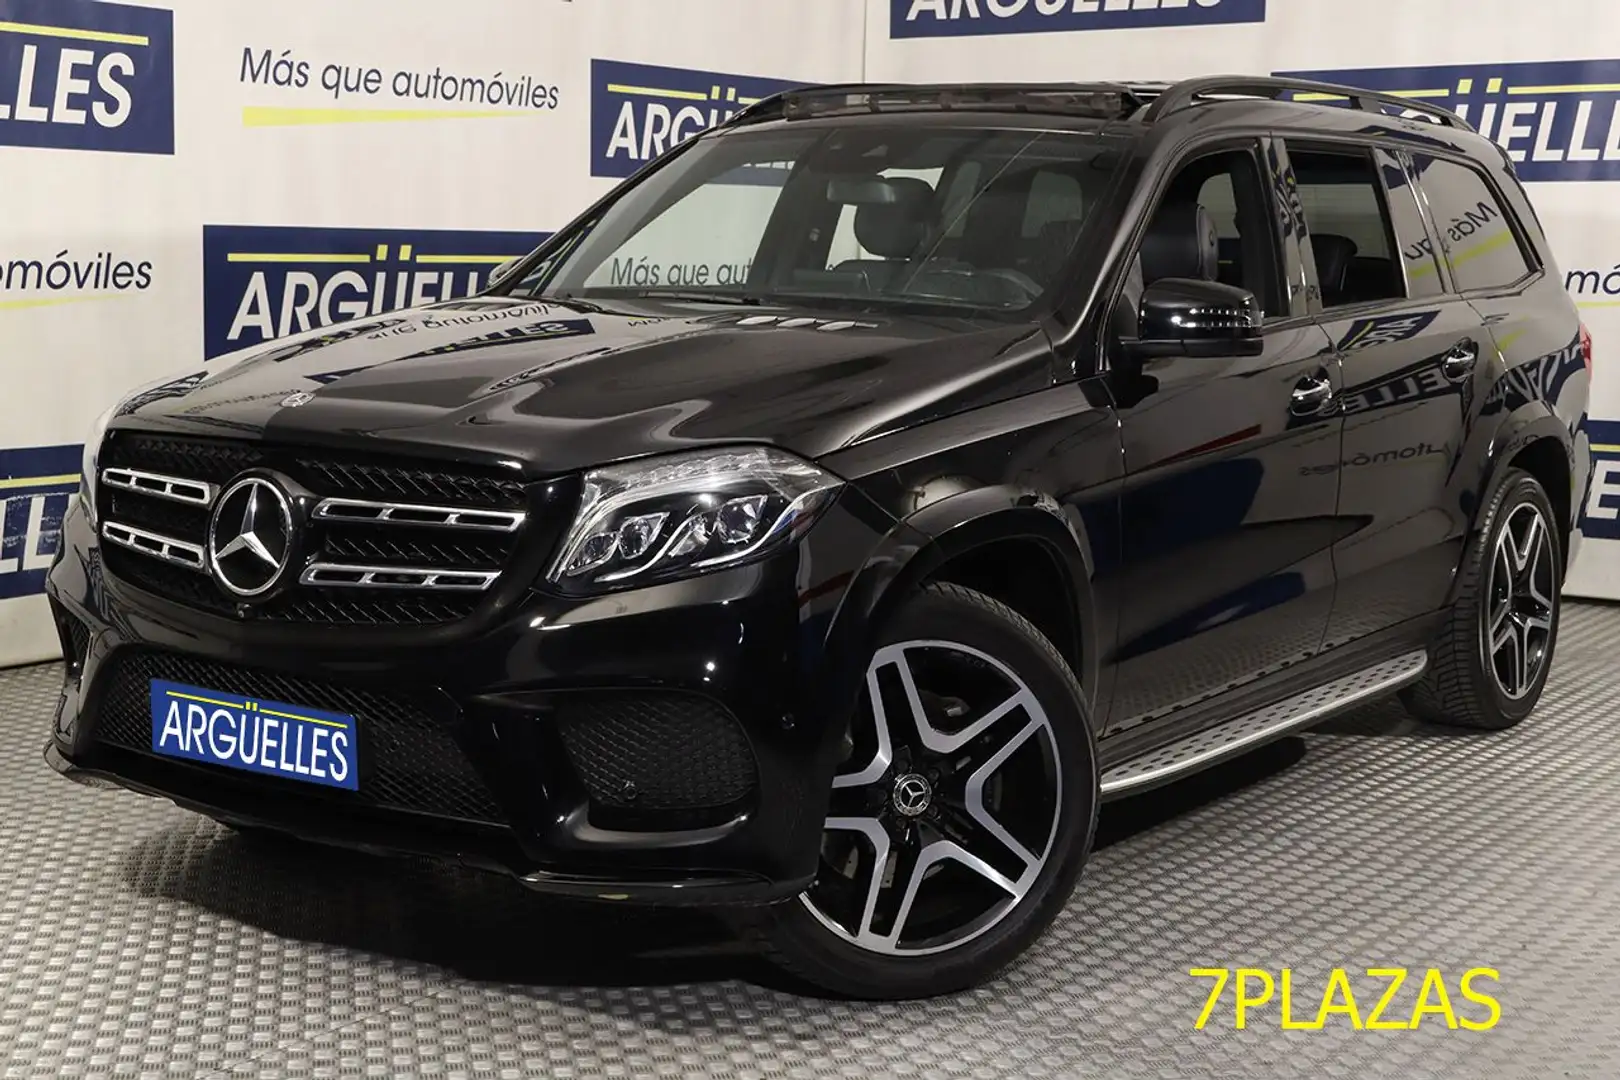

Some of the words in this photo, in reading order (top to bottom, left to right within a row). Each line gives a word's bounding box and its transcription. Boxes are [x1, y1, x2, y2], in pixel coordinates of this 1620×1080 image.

[240, 47, 310, 87] Más
[321, 64, 382, 99] que
[392, 67, 560, 110] automóviles
[0, 249, 153, 290] móviles
[611, 256, 661, 285] Más
[160, 701, 348, 782] ARGÜELLES
